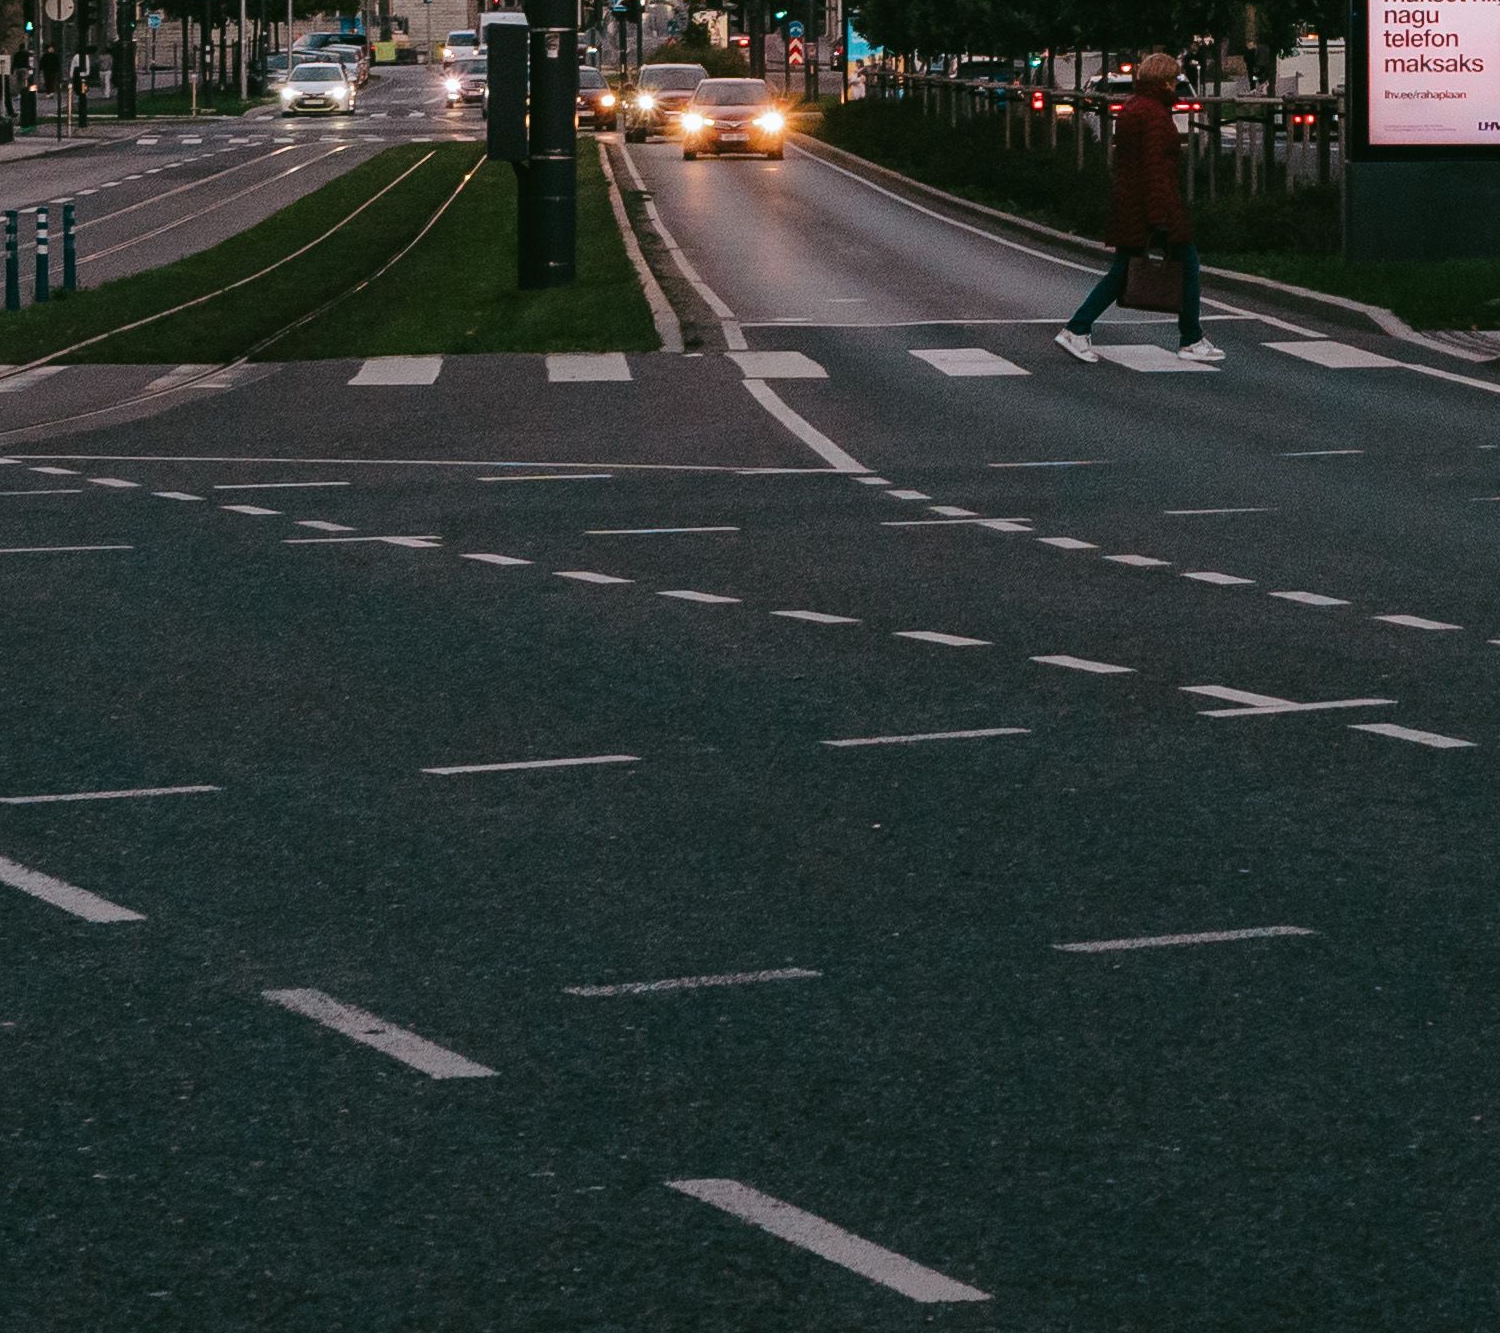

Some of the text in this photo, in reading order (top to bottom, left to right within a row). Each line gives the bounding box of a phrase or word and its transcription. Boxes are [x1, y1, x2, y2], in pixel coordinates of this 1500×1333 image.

[1384, 9, 1439, 29] nagu
[1384, 29, 1459, 48] telefon
[1384, 54, 1484, 73] maksaks
